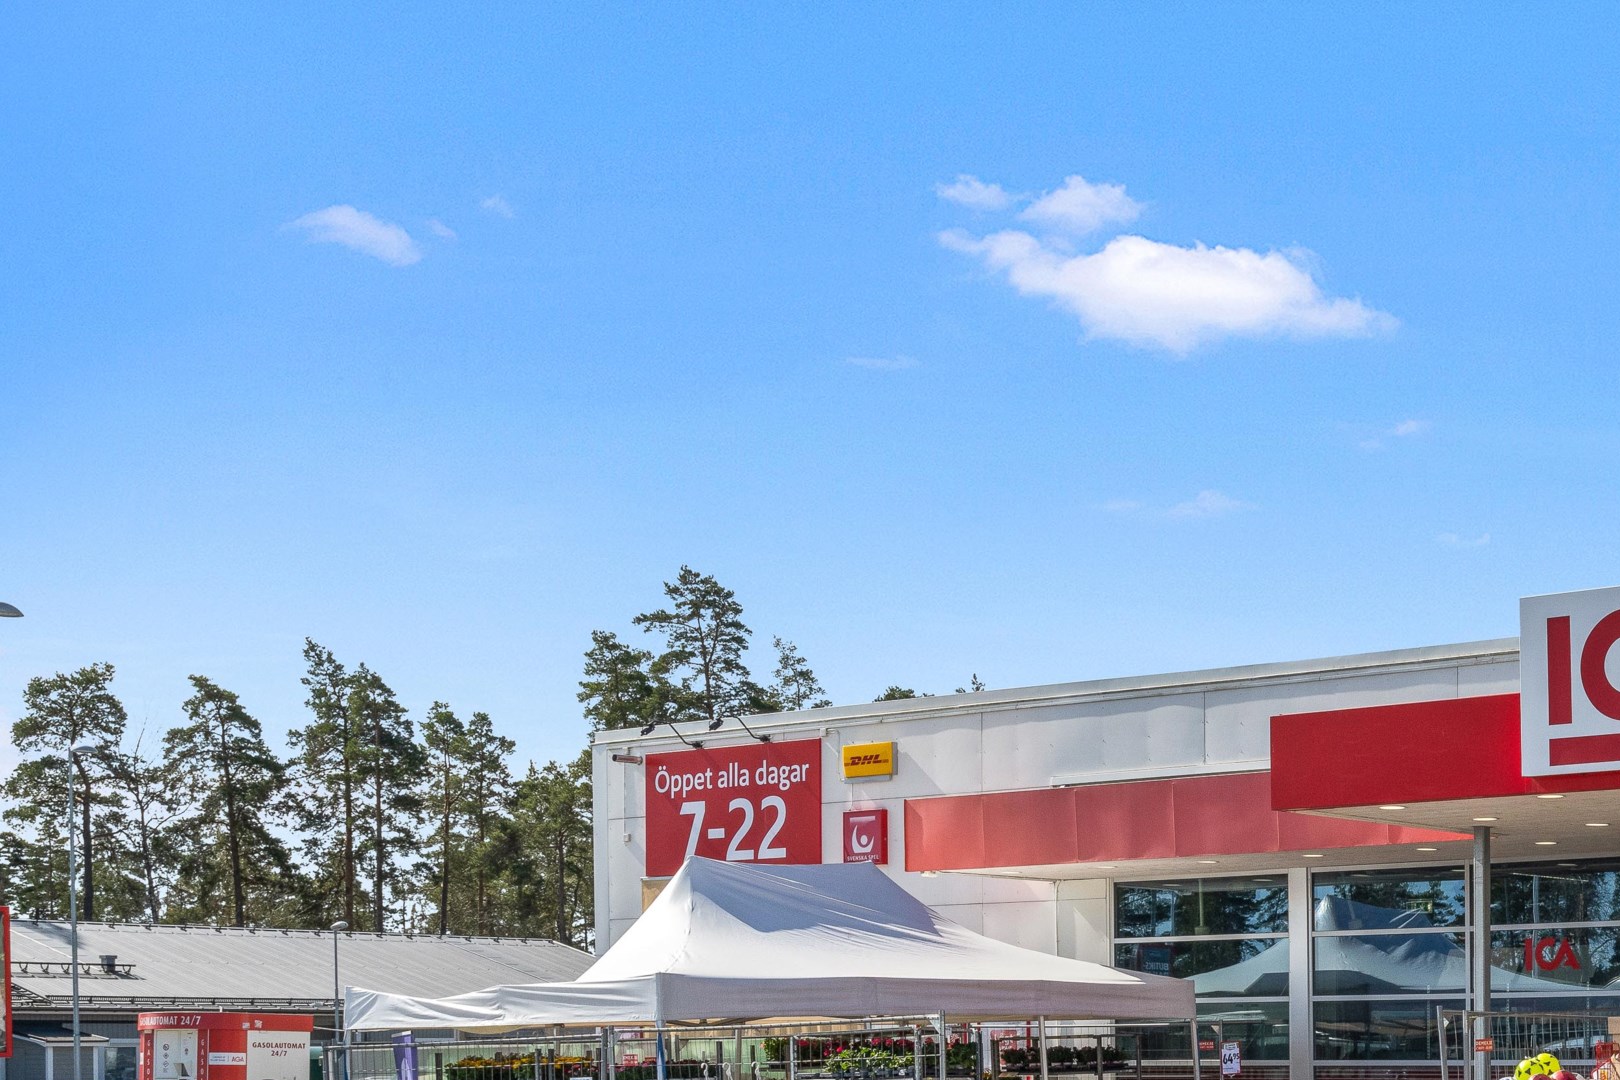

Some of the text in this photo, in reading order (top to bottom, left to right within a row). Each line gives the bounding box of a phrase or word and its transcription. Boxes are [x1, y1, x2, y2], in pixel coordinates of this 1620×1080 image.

[849, 754, 882, 766] DHL
[655, 760, 809, 798] Öppet alla dagar
[679, 795, 787, 862] 7-22
[847, 854, 868, 862] SVENSKA
[1524, 936, 1581, 973] ICA
[140, 1015, 202, 1026] GASOLAUTOMAT 24/7
[252, 1041, 306, 1049] GASOLAUTOMAT
[231, 1055, 245, 1063] AGA
